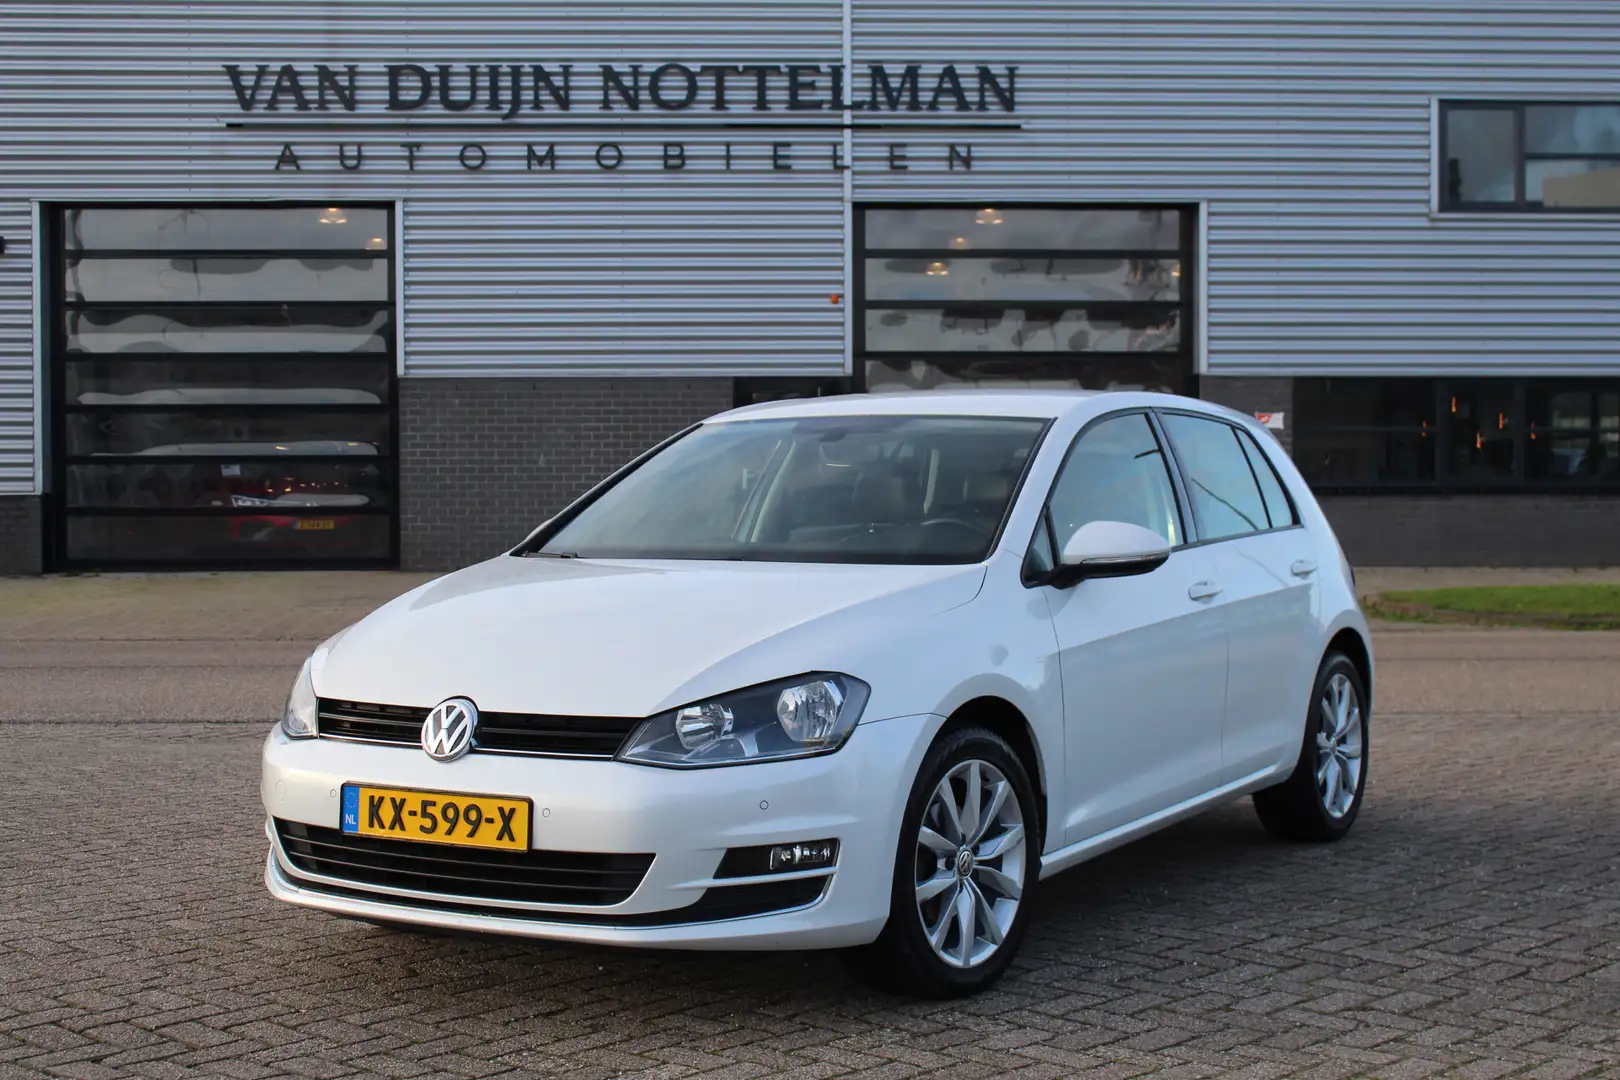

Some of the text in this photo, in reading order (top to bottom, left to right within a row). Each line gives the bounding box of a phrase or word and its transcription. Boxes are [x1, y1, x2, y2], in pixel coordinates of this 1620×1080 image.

[222, 63, 1019, 120] VAN DUIJN NOTTELMAN
[274, 143, 973, 171] AUTOMOBIELEN
[345, 813, 357, 825] NL
[368, 795, 516, 842] KX-599-X
